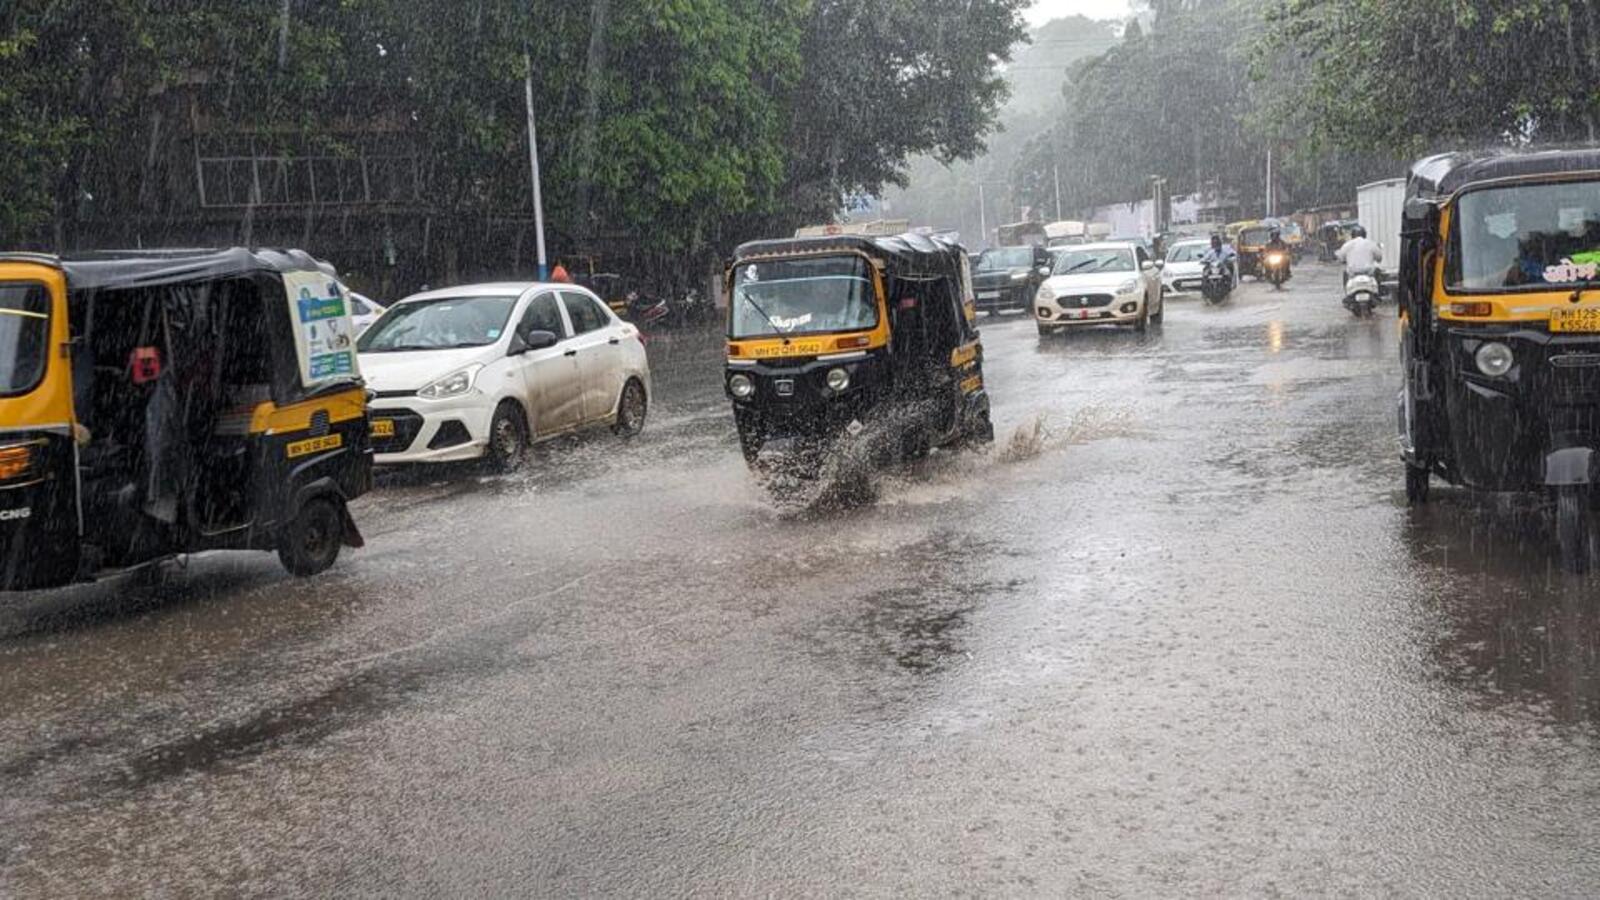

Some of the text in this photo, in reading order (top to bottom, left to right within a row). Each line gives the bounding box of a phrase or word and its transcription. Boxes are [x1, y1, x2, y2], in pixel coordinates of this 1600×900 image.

[755, 346, 769, 355] MH
[770, 346, 780, 355] 12
[0, 507, 31, 520] CNG
